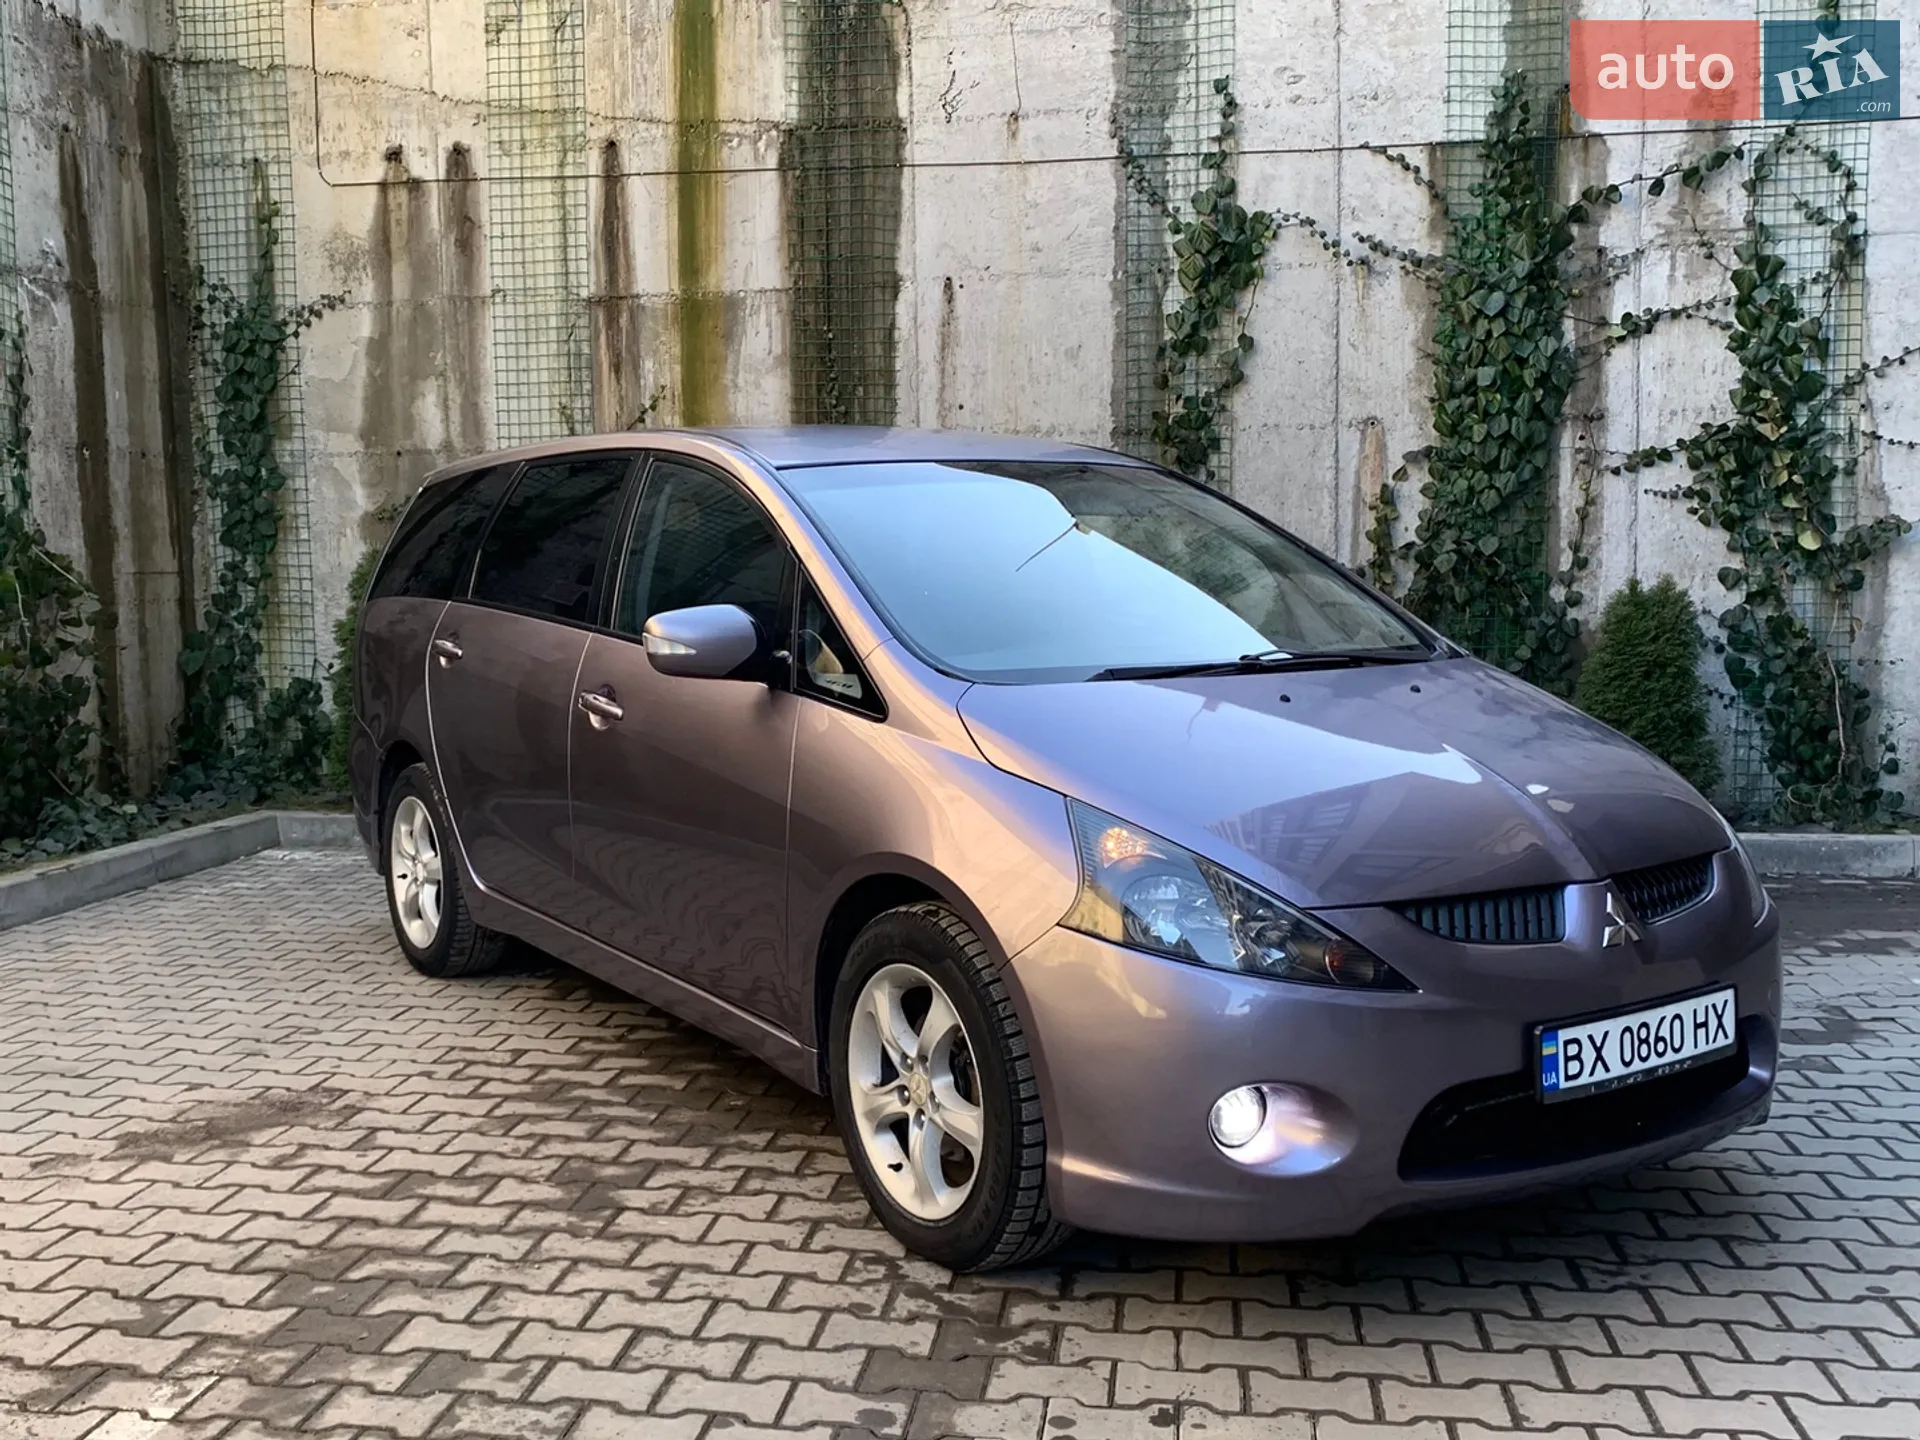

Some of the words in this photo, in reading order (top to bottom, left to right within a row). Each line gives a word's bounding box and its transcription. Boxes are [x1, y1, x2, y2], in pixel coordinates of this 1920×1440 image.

[1563, 1029, 1611, 1082] BX
[1619, 1013, 1685, 1068] 0860
[1693, 999, 1729, 1050] HX
[1542, 1073, 1558, 1086] UA
